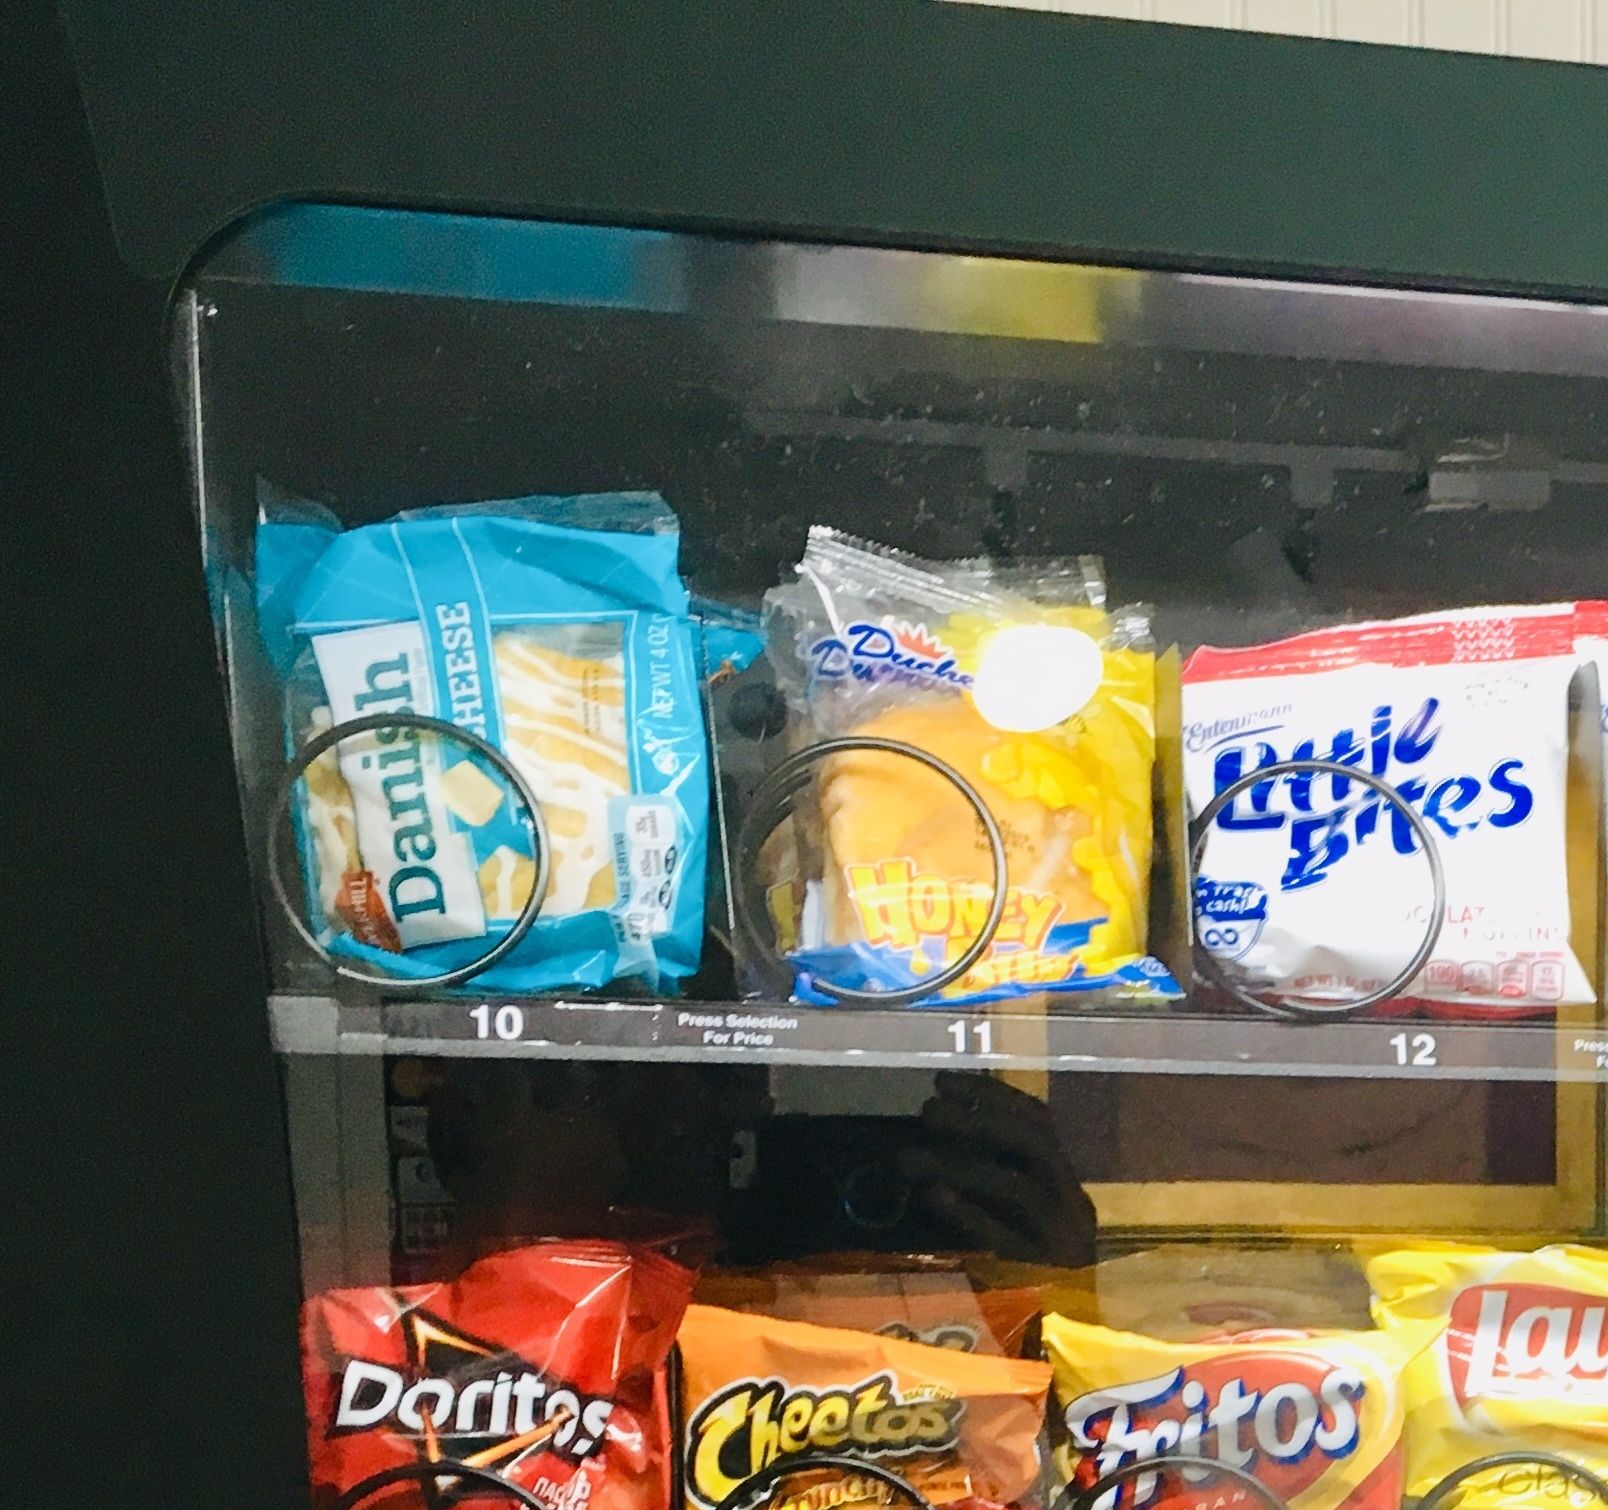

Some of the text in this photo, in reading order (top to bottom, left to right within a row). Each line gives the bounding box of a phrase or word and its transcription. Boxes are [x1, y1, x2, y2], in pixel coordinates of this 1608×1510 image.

[848, 623, 980, 685] Duche
[355, 652, 448, 924] Danish
[848, 857, 1065, 955] HONEY
[469, 1005, 525, 1041] 10
[677, 1012, 799, 1029] Press Selection
[703, 1030, 774, 1046] For Price
[948, 1020, 993, 1053] 11
[1389, 1034, 1437, 1066] 12
[335, 1358, 615, 1456] Doritos
